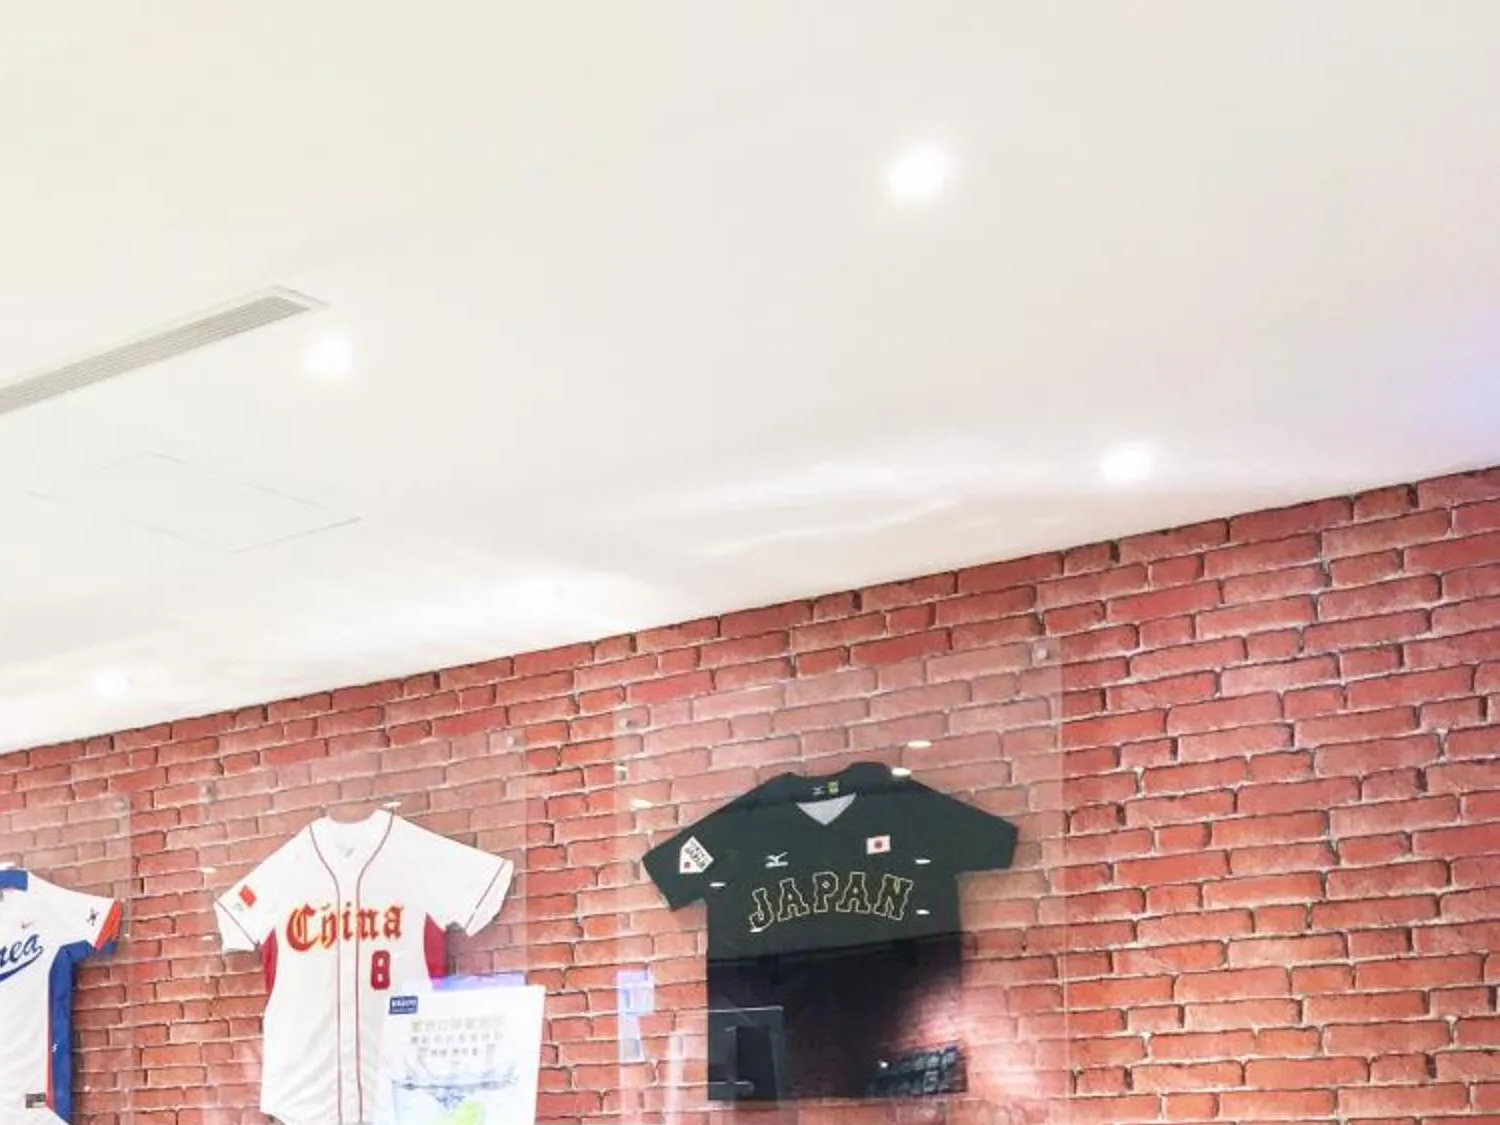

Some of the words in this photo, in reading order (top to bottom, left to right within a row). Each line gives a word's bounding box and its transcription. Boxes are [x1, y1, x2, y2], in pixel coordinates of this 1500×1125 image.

[286, 901, 404, 952] China
[749, 871, 914, 933] JAPAN
[370, 950, 391, 991] 8
